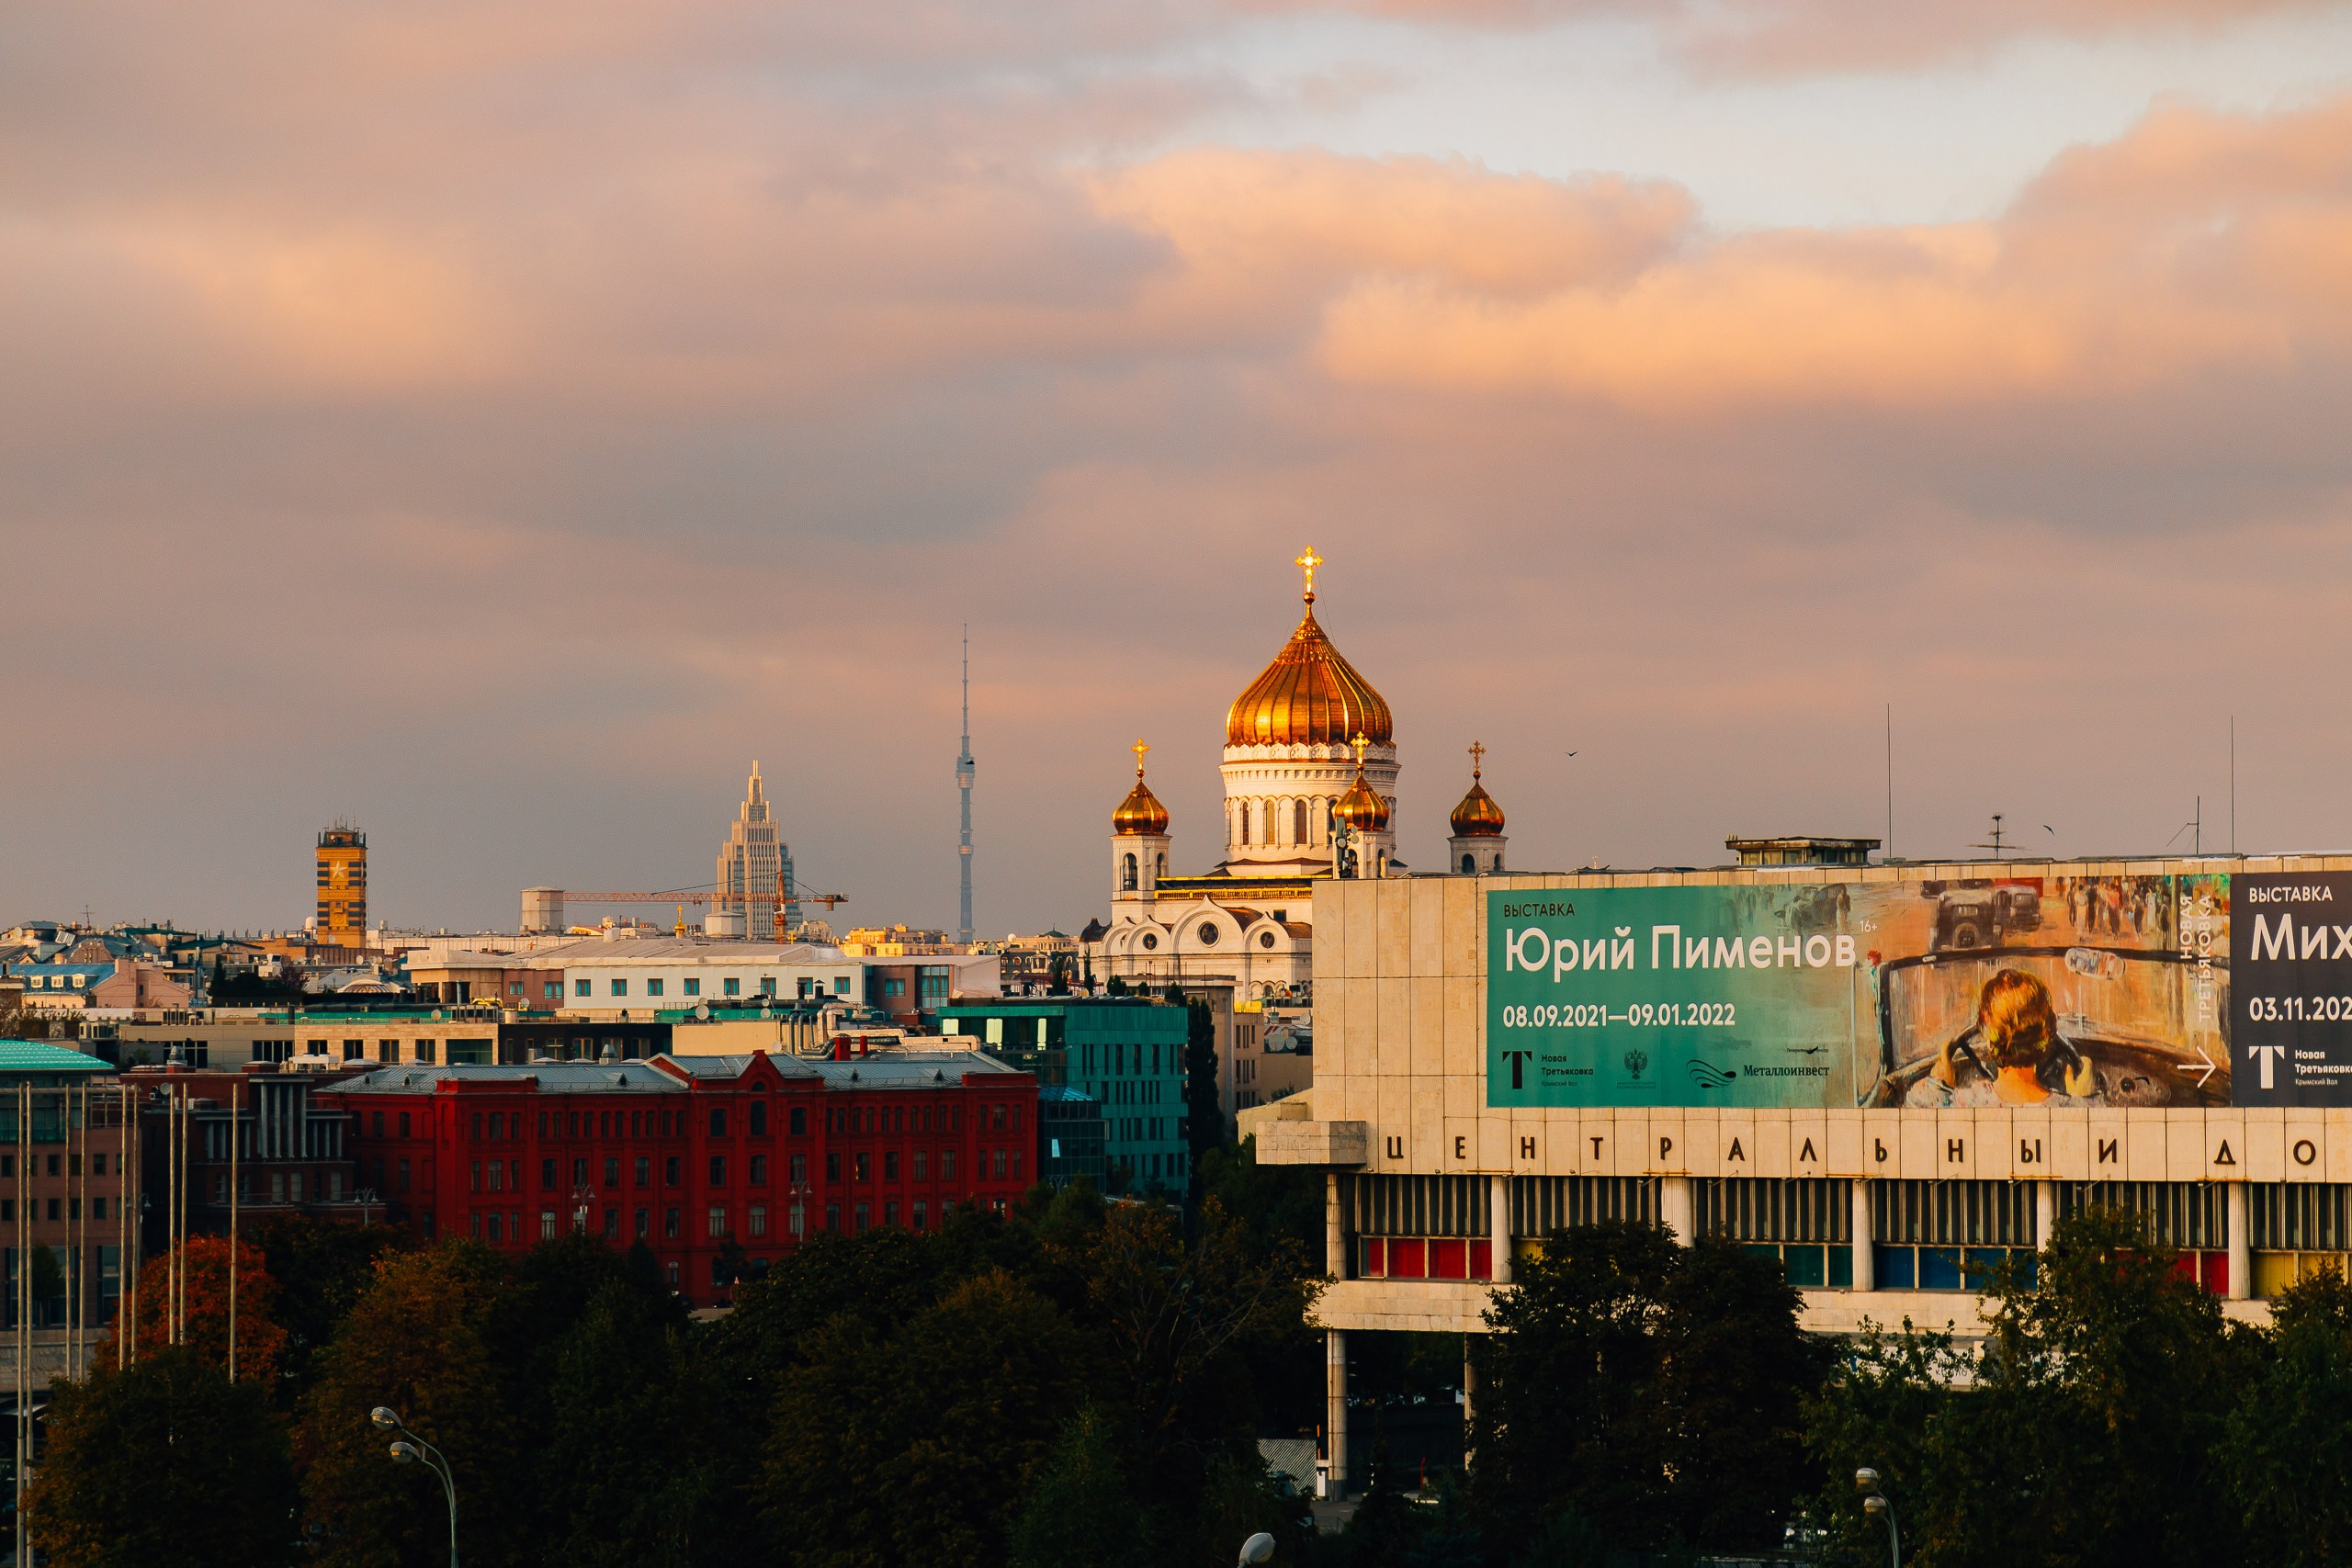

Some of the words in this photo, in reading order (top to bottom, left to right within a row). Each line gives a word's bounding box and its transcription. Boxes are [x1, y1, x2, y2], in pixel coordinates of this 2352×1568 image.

[2249, 886, 2333, 903] ВЫСТАВКА
[1503, 902, 1576, 917] ВЫСТАВКА
[1860, 919, 1878, 932] 16+
[2180, 896, 2193, 960] НОВАЯ
[2251, 913, 2352, 961] Мих
[1506, 926, 1634, 983] Юрий
[1652, 925, 1856, 970] Пименов
[2199, 895, 2211, 1022] ТРЕТЬЯКОВКА
[2250, 996, 2352, 1021] 03.11.202
[1541, 1054, 1567, 1063] Новая
[2295, 1049, 2325, 1060] Новая
[1541, 1067, 1594, 1077] Третьяковка
[1744, 1065, 1829, 1077] Металлоинвест
[2295, 1063, 2352, 1075] Третьяковк
[2295, 1077, 2325, 1086] Крымский
